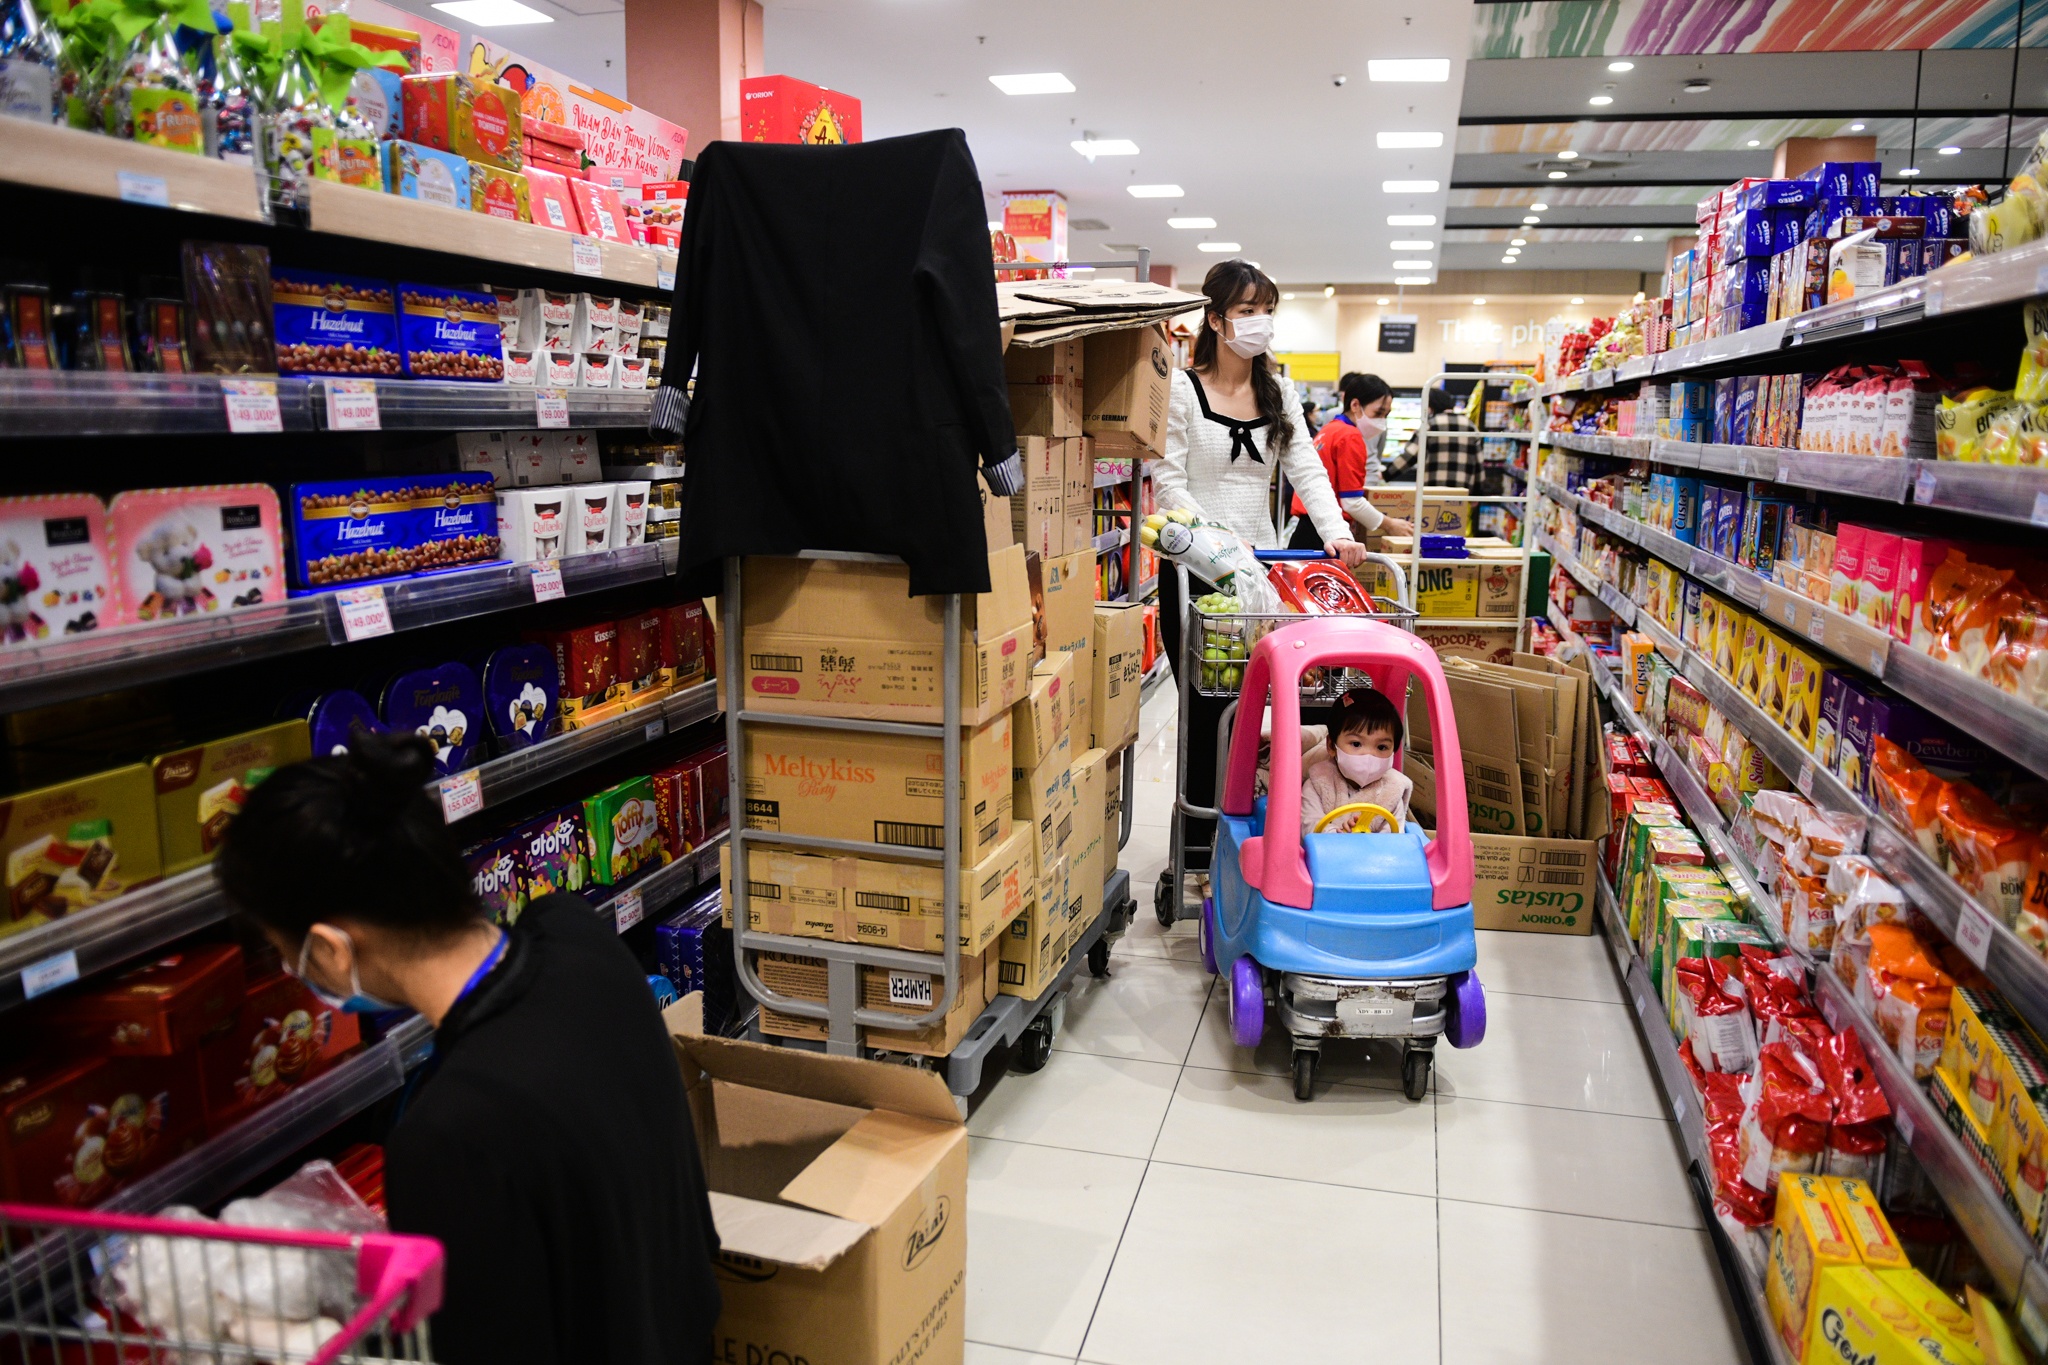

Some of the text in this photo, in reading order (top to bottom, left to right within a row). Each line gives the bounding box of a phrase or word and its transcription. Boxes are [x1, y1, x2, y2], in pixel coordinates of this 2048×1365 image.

[752, 91, 774, 99] ORION
[1778, 195, 1804, 204] OREO
[1762, 220, 1771, 246] OREO
[1790, 220, 1799, 246] OREO
[1940, 208, 1948, 235] OREO
[1761, 268, 1769, 294] OREO
[311, 310, 364, 335] Hazelnut
[543, 306, 641, 329] Raffaello Raffaello Raffaello
[434, 321, 478, 343] Hazelnut
[1511, 319, 1543, 347] ph
[507, 365, 646, 384] Raffaello Raffaello Raffaello Raffaello
[1736, 390, 1755, 411] OREO
[1101, 414, 1128, 423] GERMANY
[434, 508, 473, 528] Hazelnut
[1674, 486, 1689, 530] Custas
[1718, 504, 1733, 522] OREO
[337, 518, 385, 541] Hazelnut
[533, 510, 645, 534] Raffaello Raffaello Raffaello
[1865, 560, 1891, 577] Dewberry
[1634, 653, 1646, 696] Custas
[764, 752, 876, 784] Meltykiss
[1748, 749, 1764, 786] Solite
[798, 777, 839, 802] Party
[1046, 777, 1060, 799] meiji
[612, 800, 646, 840] Toffix
[1496, 889, 1584, 914] Custas
[1520, 913, 1561, 926] ORION
[891, 977, 932, 1000] HAMPER
[920, 1269, 964, 1330] TOP BRAND
[931, 1310, 949, 1342] 1913
